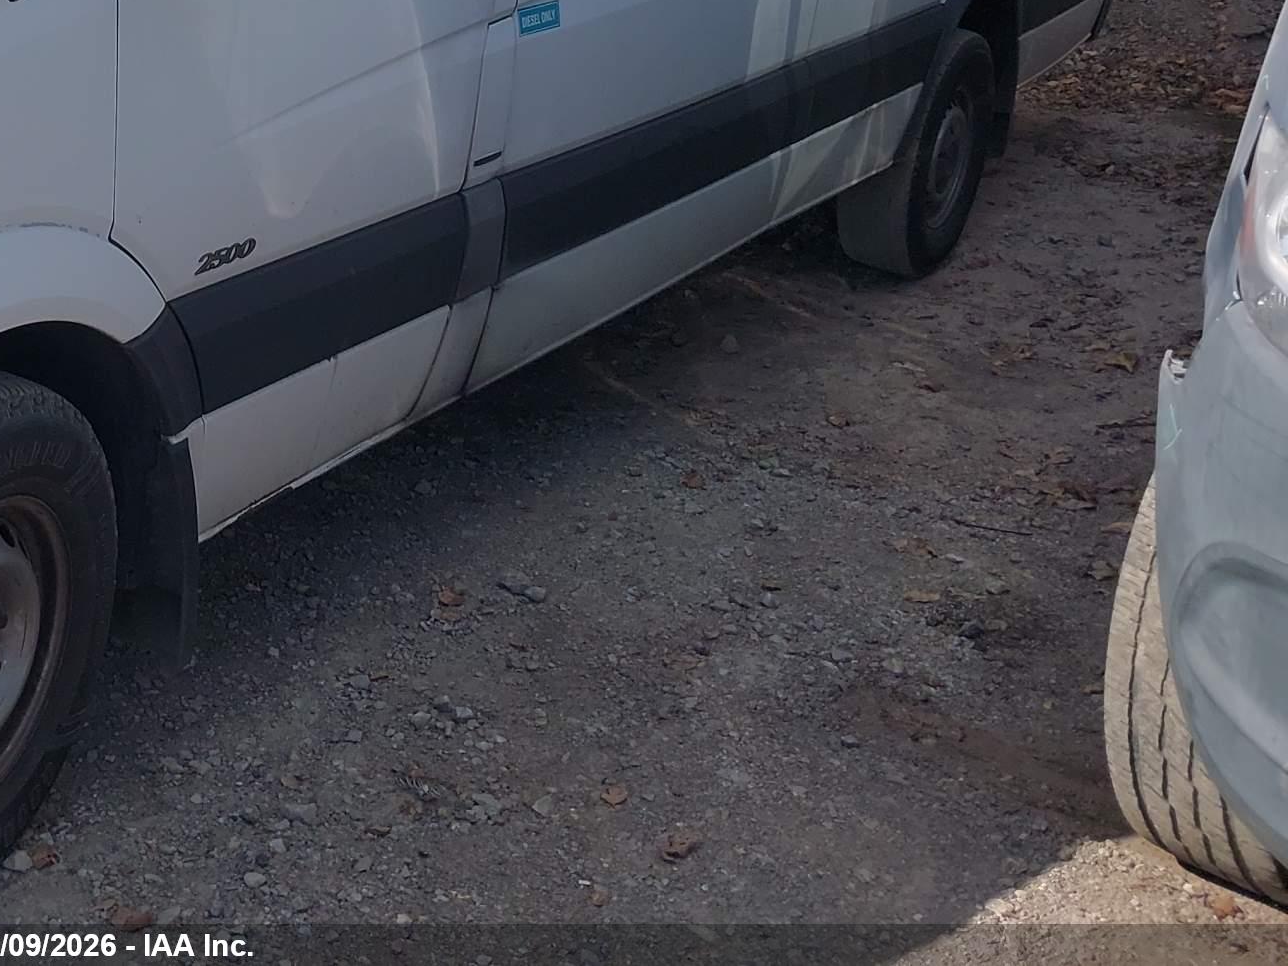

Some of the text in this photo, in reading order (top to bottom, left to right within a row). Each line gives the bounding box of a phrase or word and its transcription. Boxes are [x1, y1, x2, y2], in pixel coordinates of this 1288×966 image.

[522, 9, 556, 28] DIESEL ONLY
[194, 238, 257, 276] 2500
